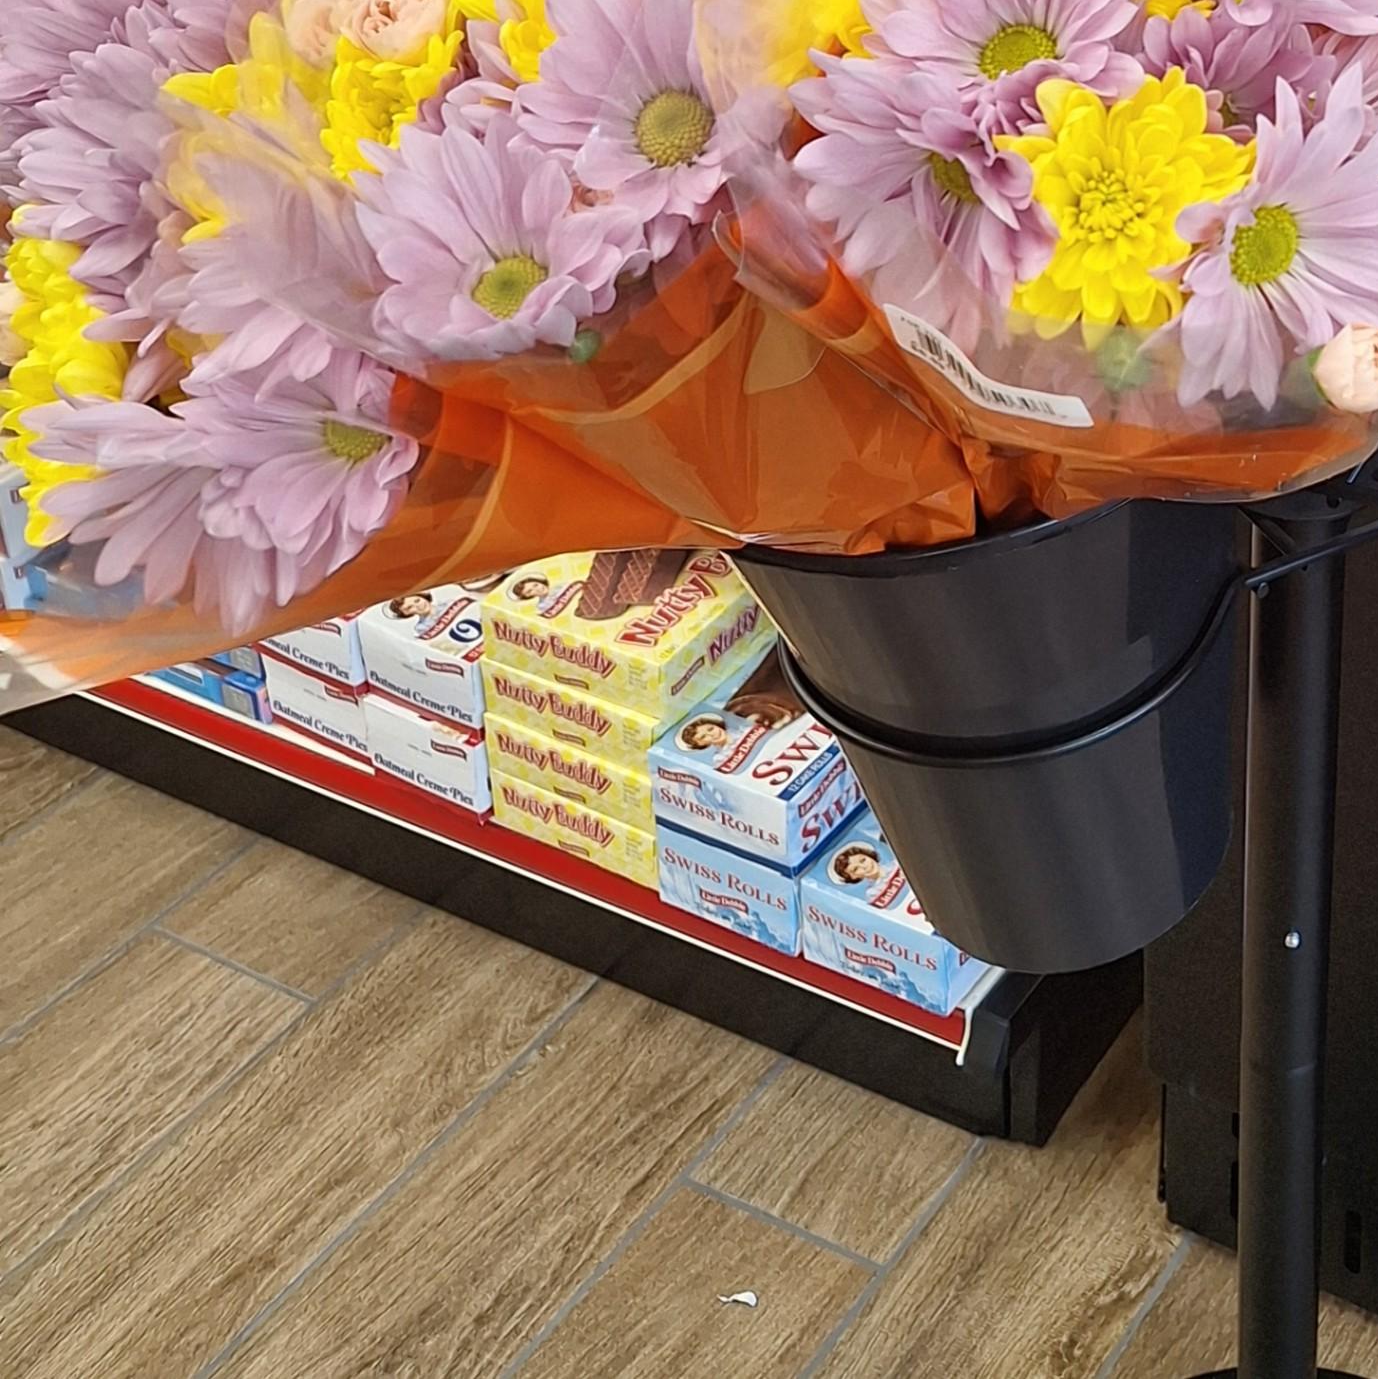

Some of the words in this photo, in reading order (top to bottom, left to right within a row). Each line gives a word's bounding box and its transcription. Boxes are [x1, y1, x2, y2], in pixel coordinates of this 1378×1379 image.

[615, 573, 719, 647] Nutty
[293, 649, 324, 669] Creme
[325, 661, 350, 680] Pies
[492, 621, 549, 658] Nutty
[550, 635, 617, 678] Buddy
[370, 670, 410, 697] Oatmeal
[412, 691, 446, 713] Creme
[447, 704, 473, 722] Pies
[492, 675, 548, 714] Nutty
[547, 691, 612, 738] Buddy
[273, 700, 312, 726] Oatmeal
[314, 717, 345, 740] Creme
[346, 734, 369, 752] Pies
[721, 747, 745, 772] Little
[742, 726, 768, 754] Debbie
[374, 752, 415, 780] Oatmeal
[416, 772, 449, 796] Creme
[449, 787, 474, 806] Pies
[495, 731, 549, 771] Nutty
[548, 749, 612, 795] Buddy
[501, 785, 553, 824] Nutty
[553, 802, 615, 848] Buddy
[660, 787, 717, 820] SWISS
[720, 811, 780, 846] ROLLS
[664, 846, 721, 883] SWISS
[726, 875, 788, 912] ROLLS
[808, 905, 867, 944] SWISS
[873, 932, 938, 971] ROLLS
